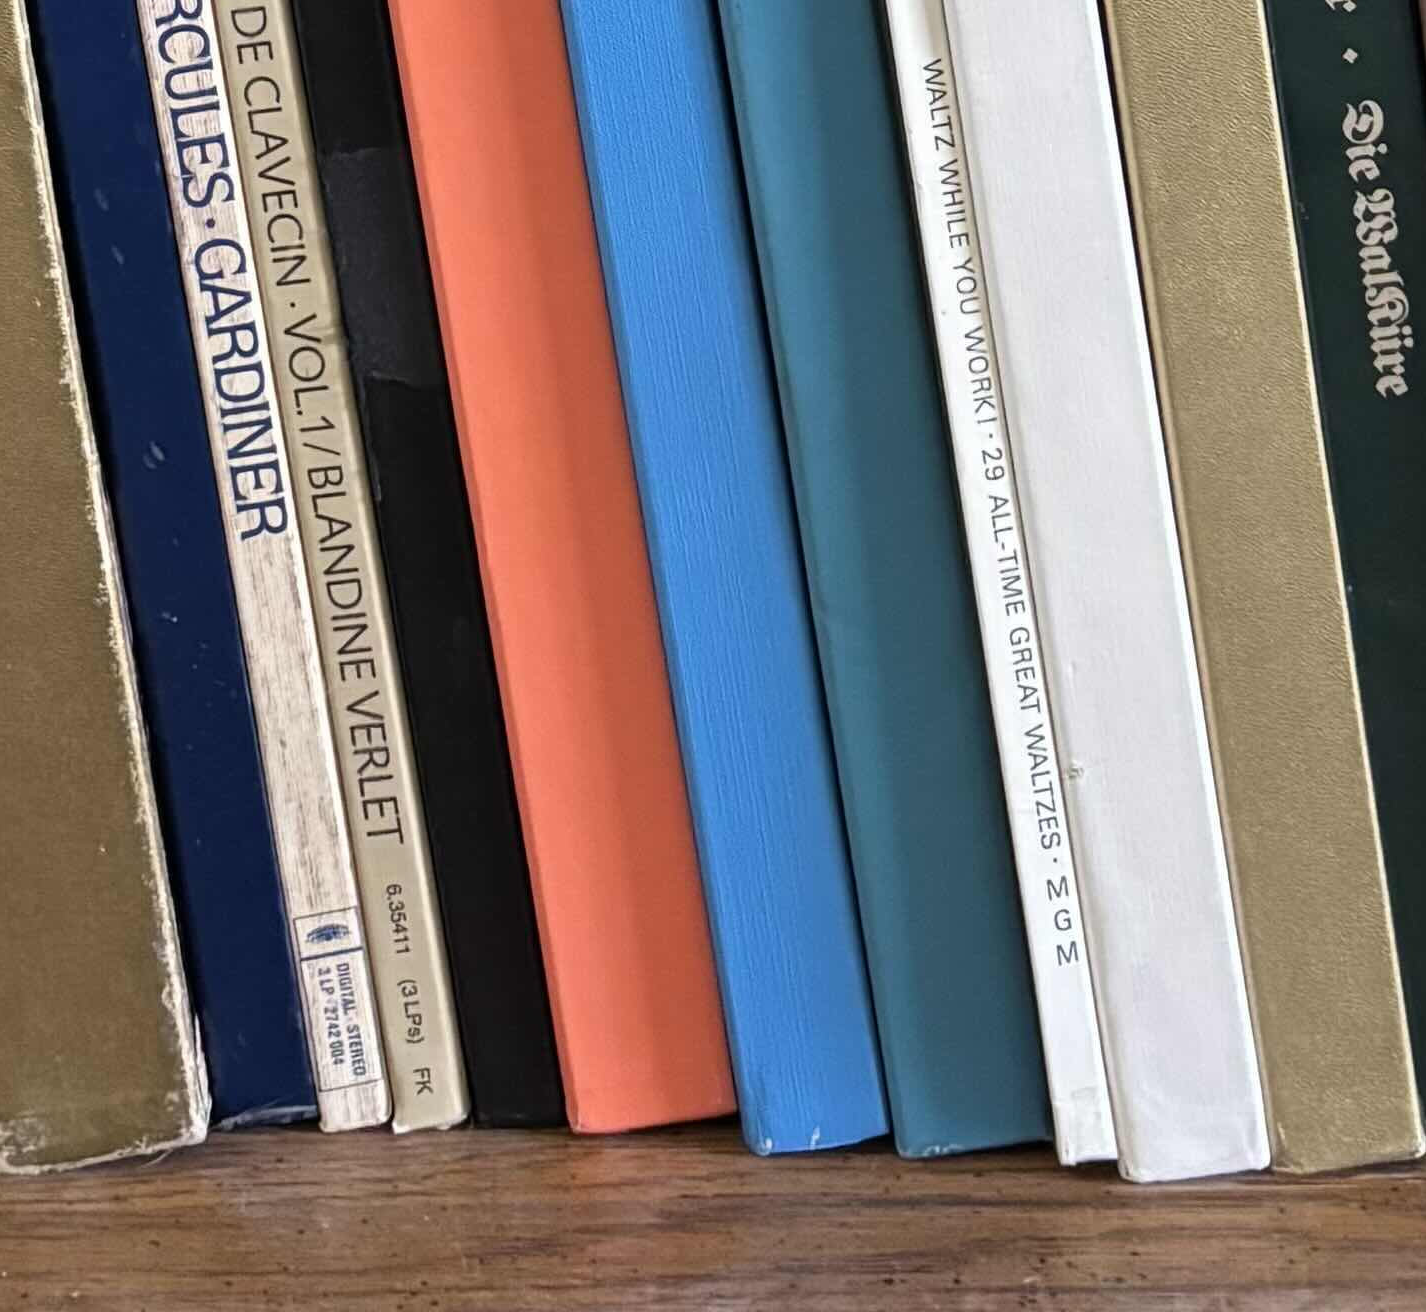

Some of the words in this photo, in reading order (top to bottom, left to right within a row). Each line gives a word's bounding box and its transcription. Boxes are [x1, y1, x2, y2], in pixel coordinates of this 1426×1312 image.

[232, 7, 274, 65] DE
[922, 59, 955, 150] WALTZ
[1342, 99, 1388, 182] Die
[243, 77, 311, 287] CLAVECIN
[938, 159, 970, 249] WHILE
[952, 258, 980, 316] YOU
[194, 239, 288, 541] GARDINER
[964, 326, 998, 425] WORK!
[981, 448, 1006, 481] 29
[988, 494, 1025, 616] ALL-TIME
[1009, 626, 1041, 713] GREAT
[346, 690, 405, 845] VERLET
[1024, 724, 1061, 849] WALTZES
[319, 979, 335, 995] LP
[336, 963, 357, 1016] DIGITAL
[386, 883, 411, 954] 6.35411
[413, 1067, 434, 1095] FK
[346, 1024, 366, 1076] STEREO
